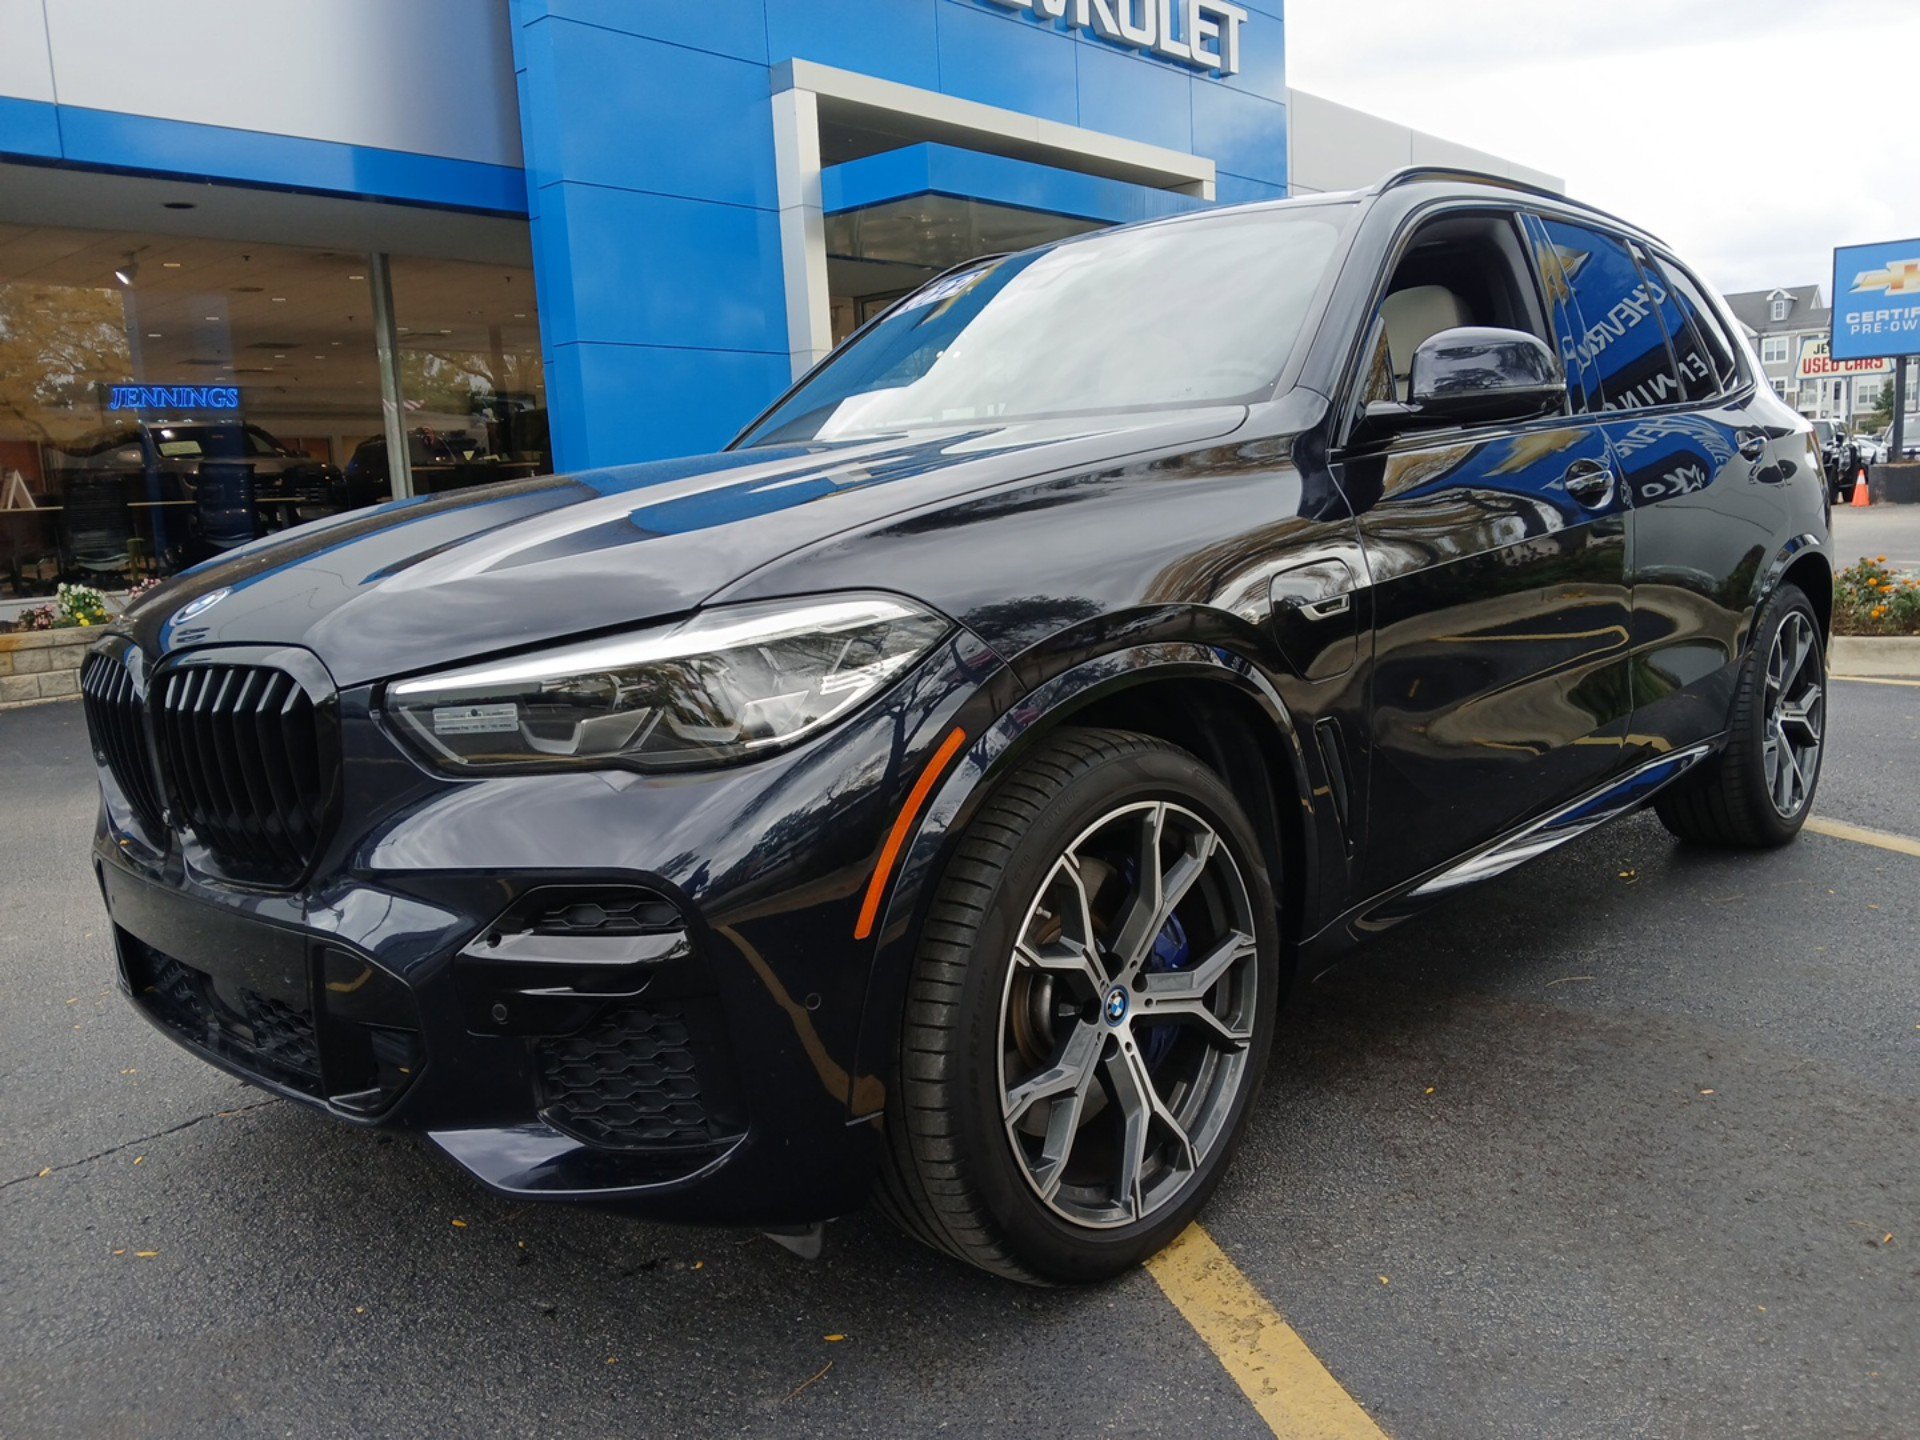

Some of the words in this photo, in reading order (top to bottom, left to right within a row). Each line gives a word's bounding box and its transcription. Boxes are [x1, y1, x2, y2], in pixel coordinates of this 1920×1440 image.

[1803, 356, 1840, 374] USED
[1845, 357, 1884, 371] CARS
[109, 386, 240, 410] JENNINGS
